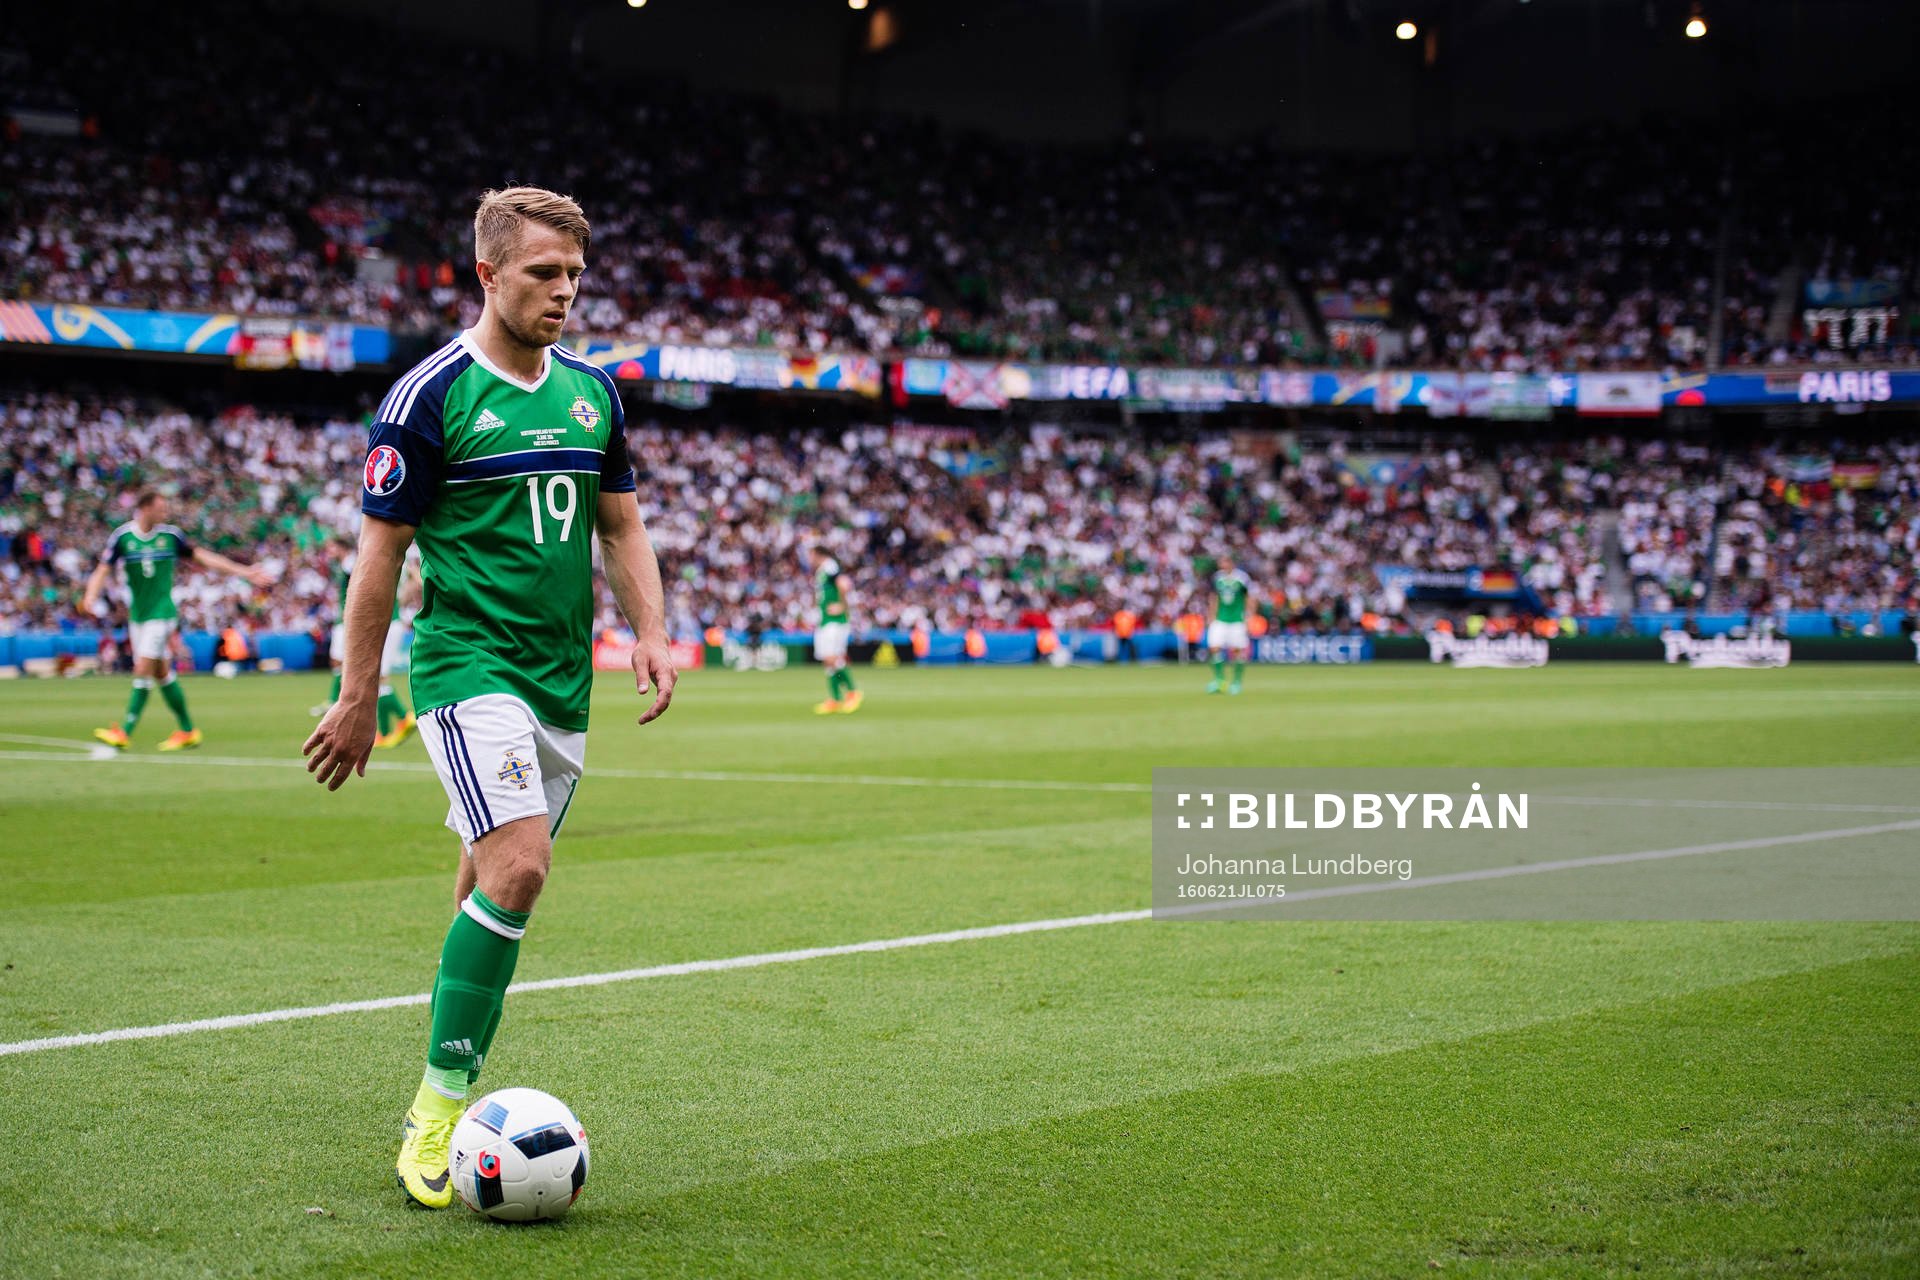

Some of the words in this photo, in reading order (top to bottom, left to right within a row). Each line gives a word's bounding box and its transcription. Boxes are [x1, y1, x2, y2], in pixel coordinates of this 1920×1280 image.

[1799, 371, 1892, 402] PARIS
[526, 475, 577, 544] 19
[1257, 633, 1365, 663] RESPECT
[440, 1043, 475, 1056] adidas
